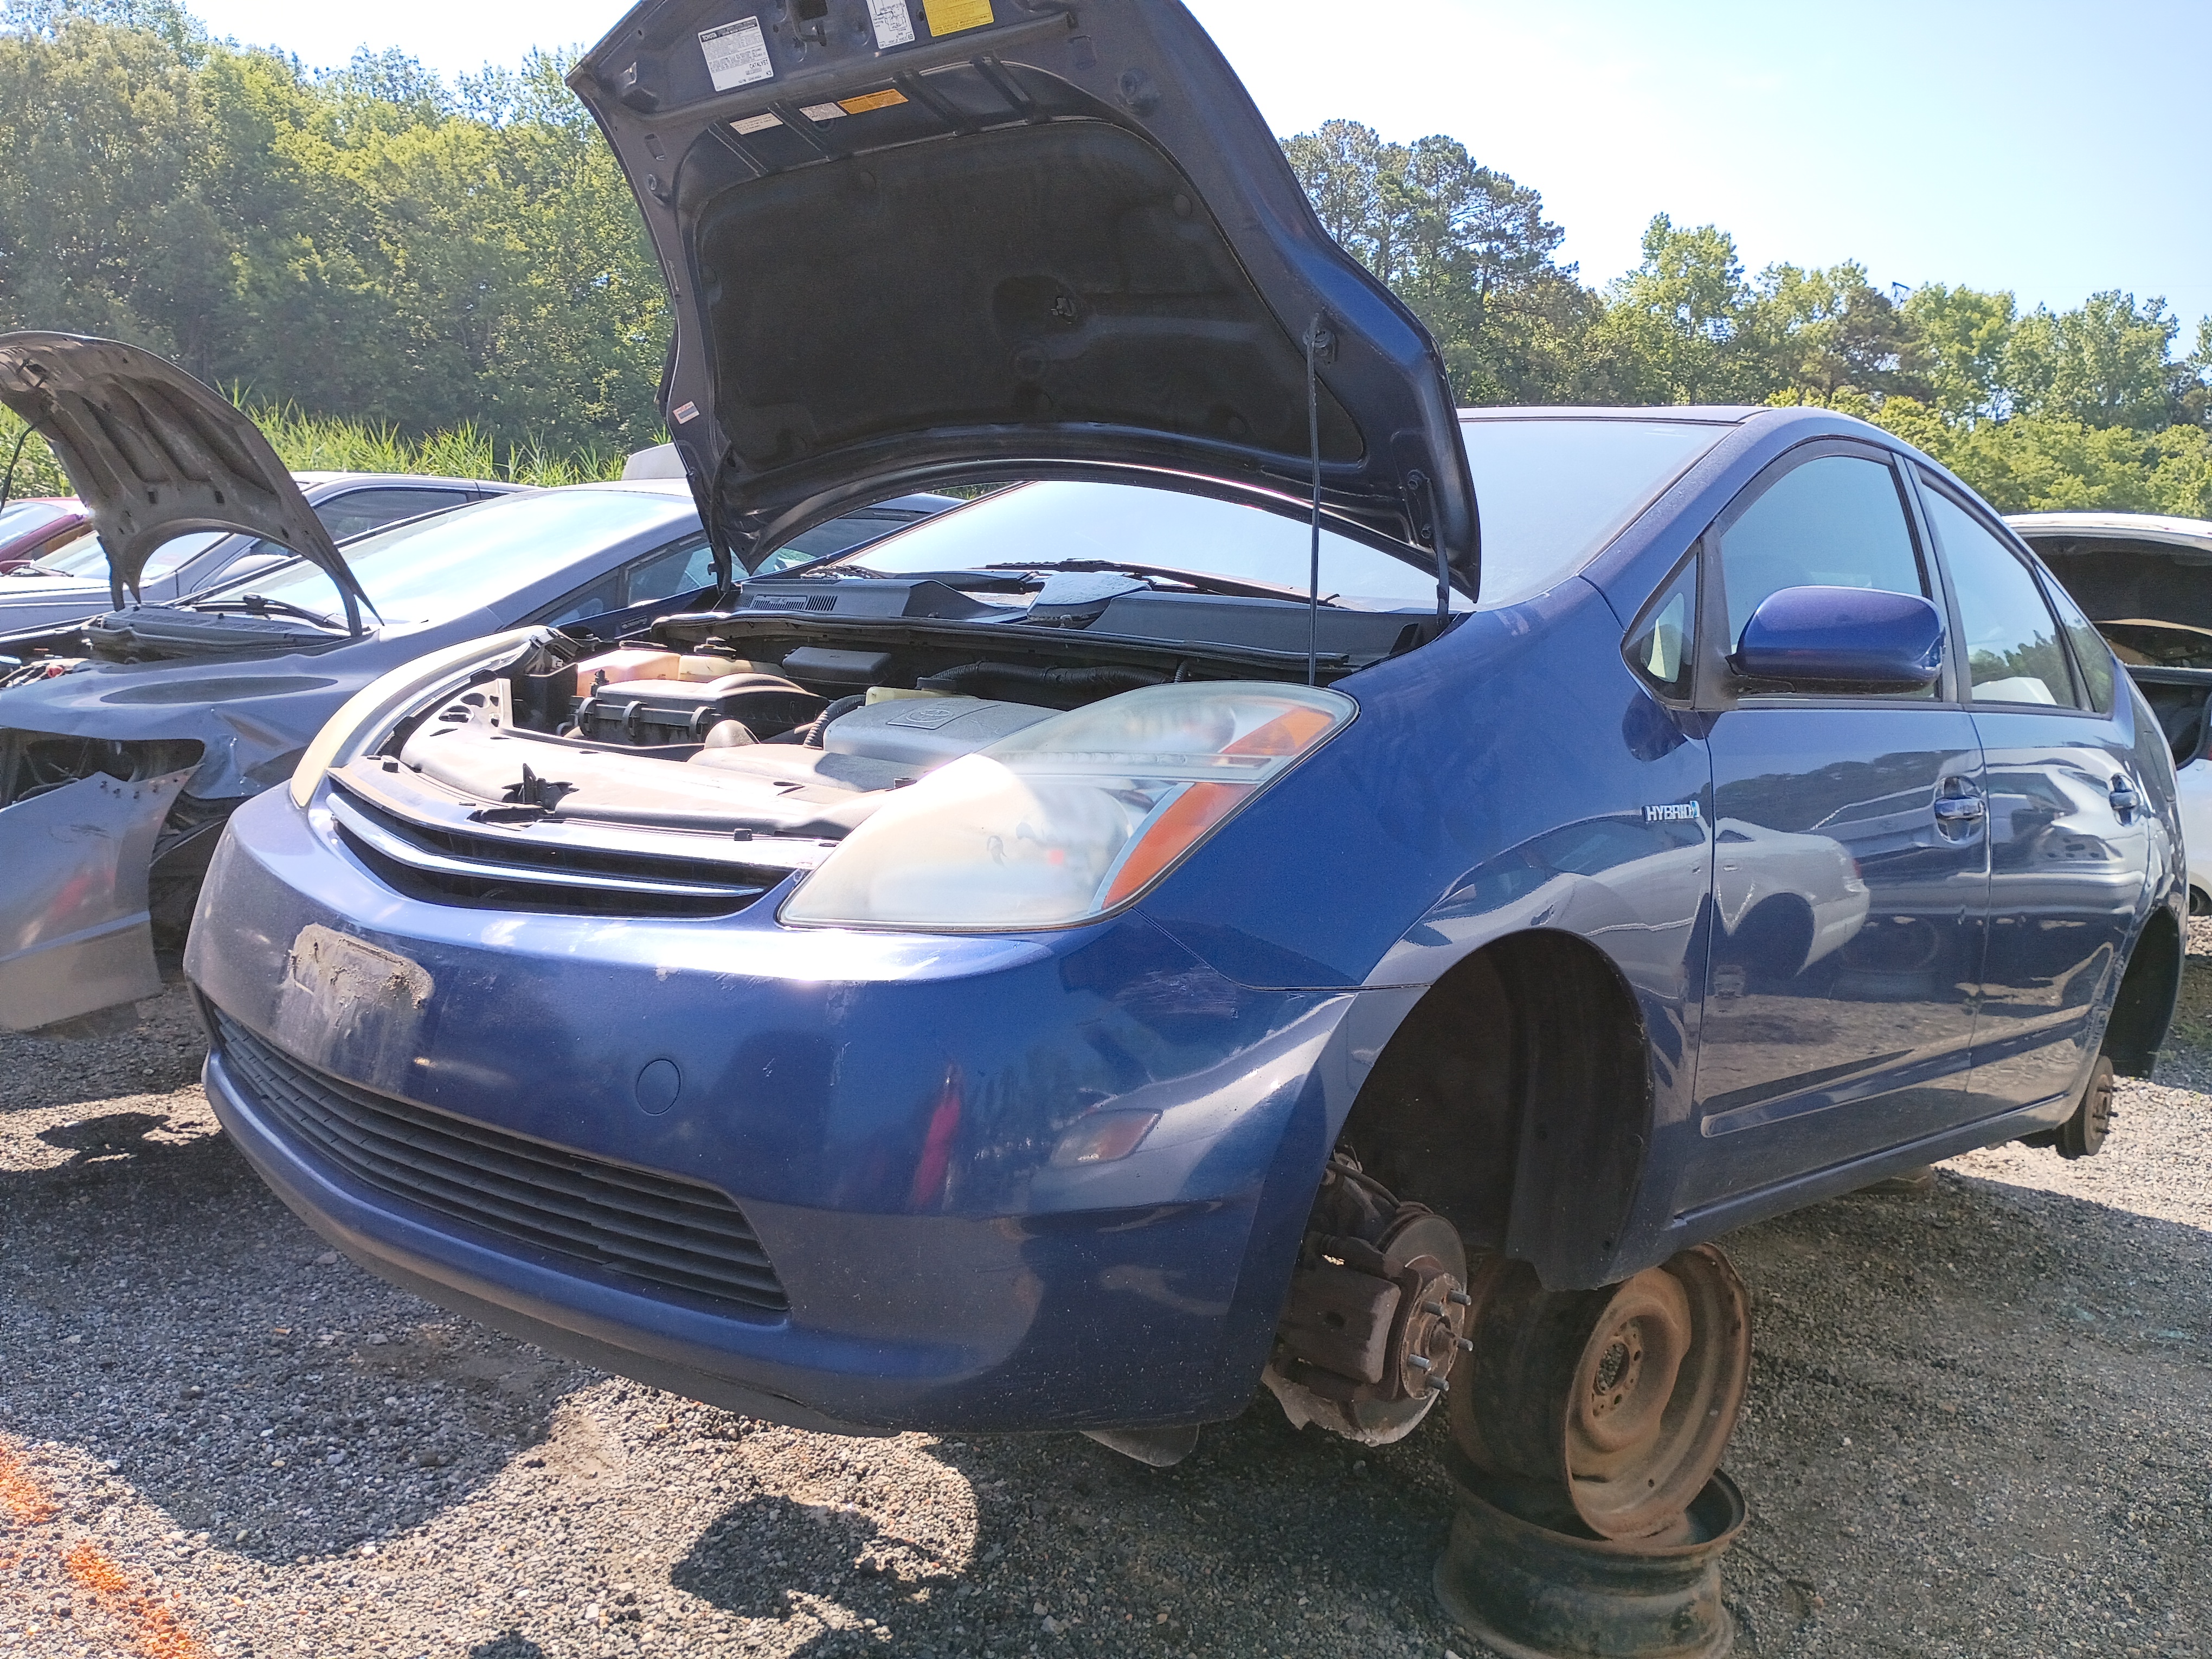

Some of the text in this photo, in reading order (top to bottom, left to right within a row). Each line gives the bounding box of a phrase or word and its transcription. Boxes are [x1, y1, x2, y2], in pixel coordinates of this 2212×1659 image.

[702, 33, 717, 41] TOYOTA
[749, 59, 768, 69] CATALYST
[1645, 804, 1694, 821] HYBRID
